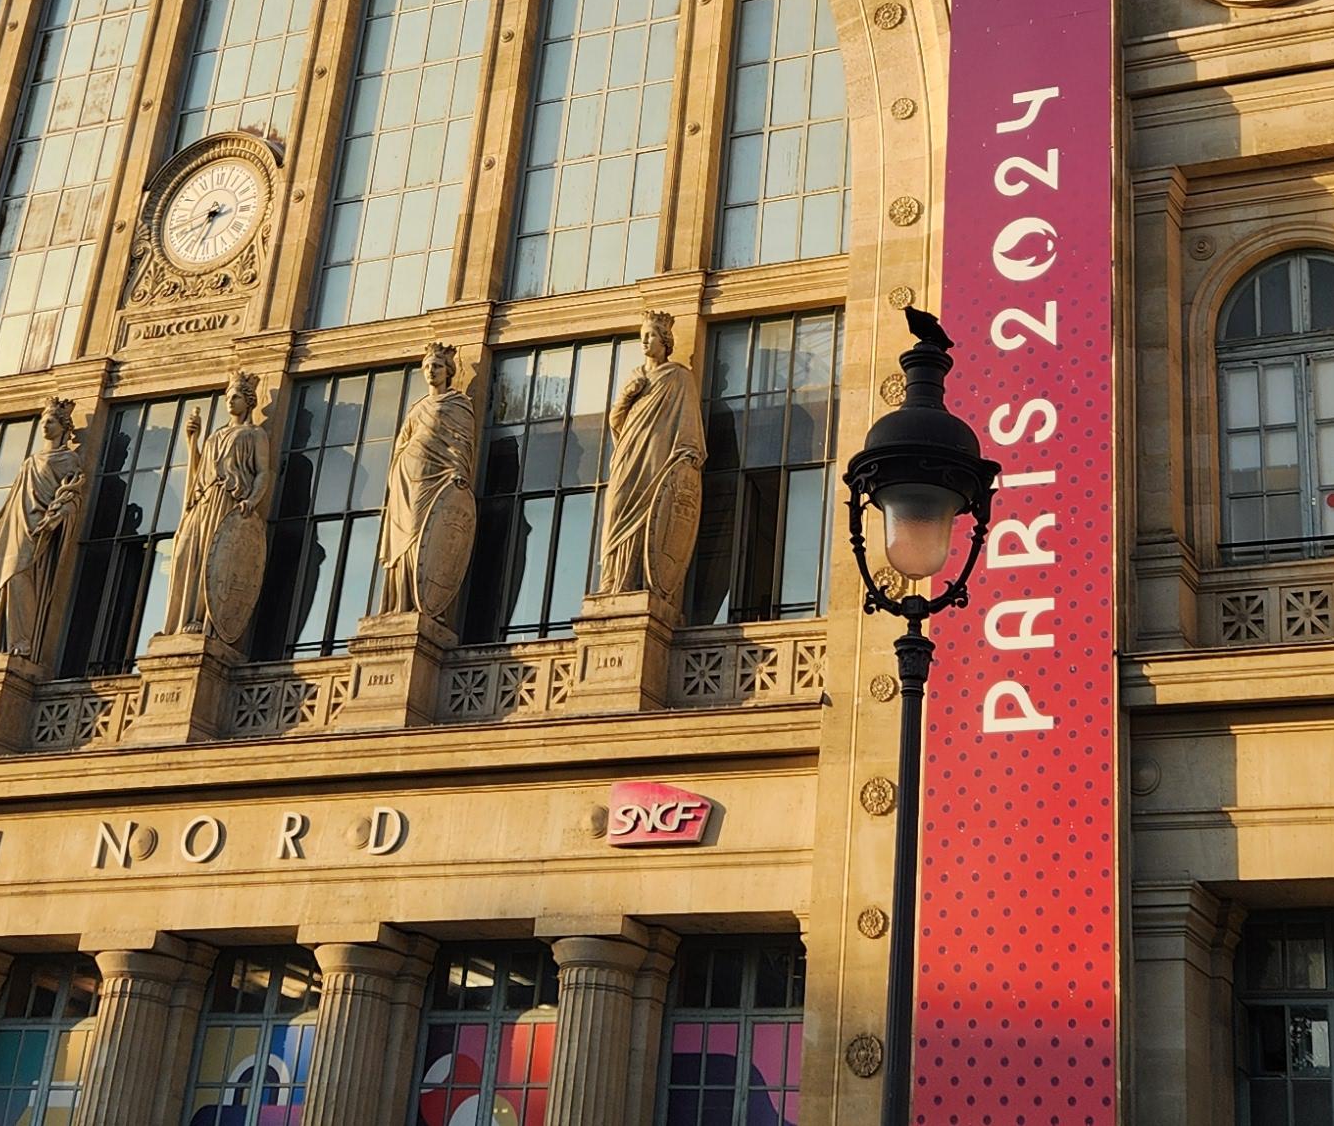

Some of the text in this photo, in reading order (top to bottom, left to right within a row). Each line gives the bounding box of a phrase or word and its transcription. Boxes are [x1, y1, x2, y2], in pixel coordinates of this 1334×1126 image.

[143, 314, 228, 339] MDCCCLXIV
[983, 86, 1059, 733] PARIS 2024
[597, 655, 624, 669] LAON
[610, 801, 702, 835] SNCF
[91, 806, 408, 869] NORD
